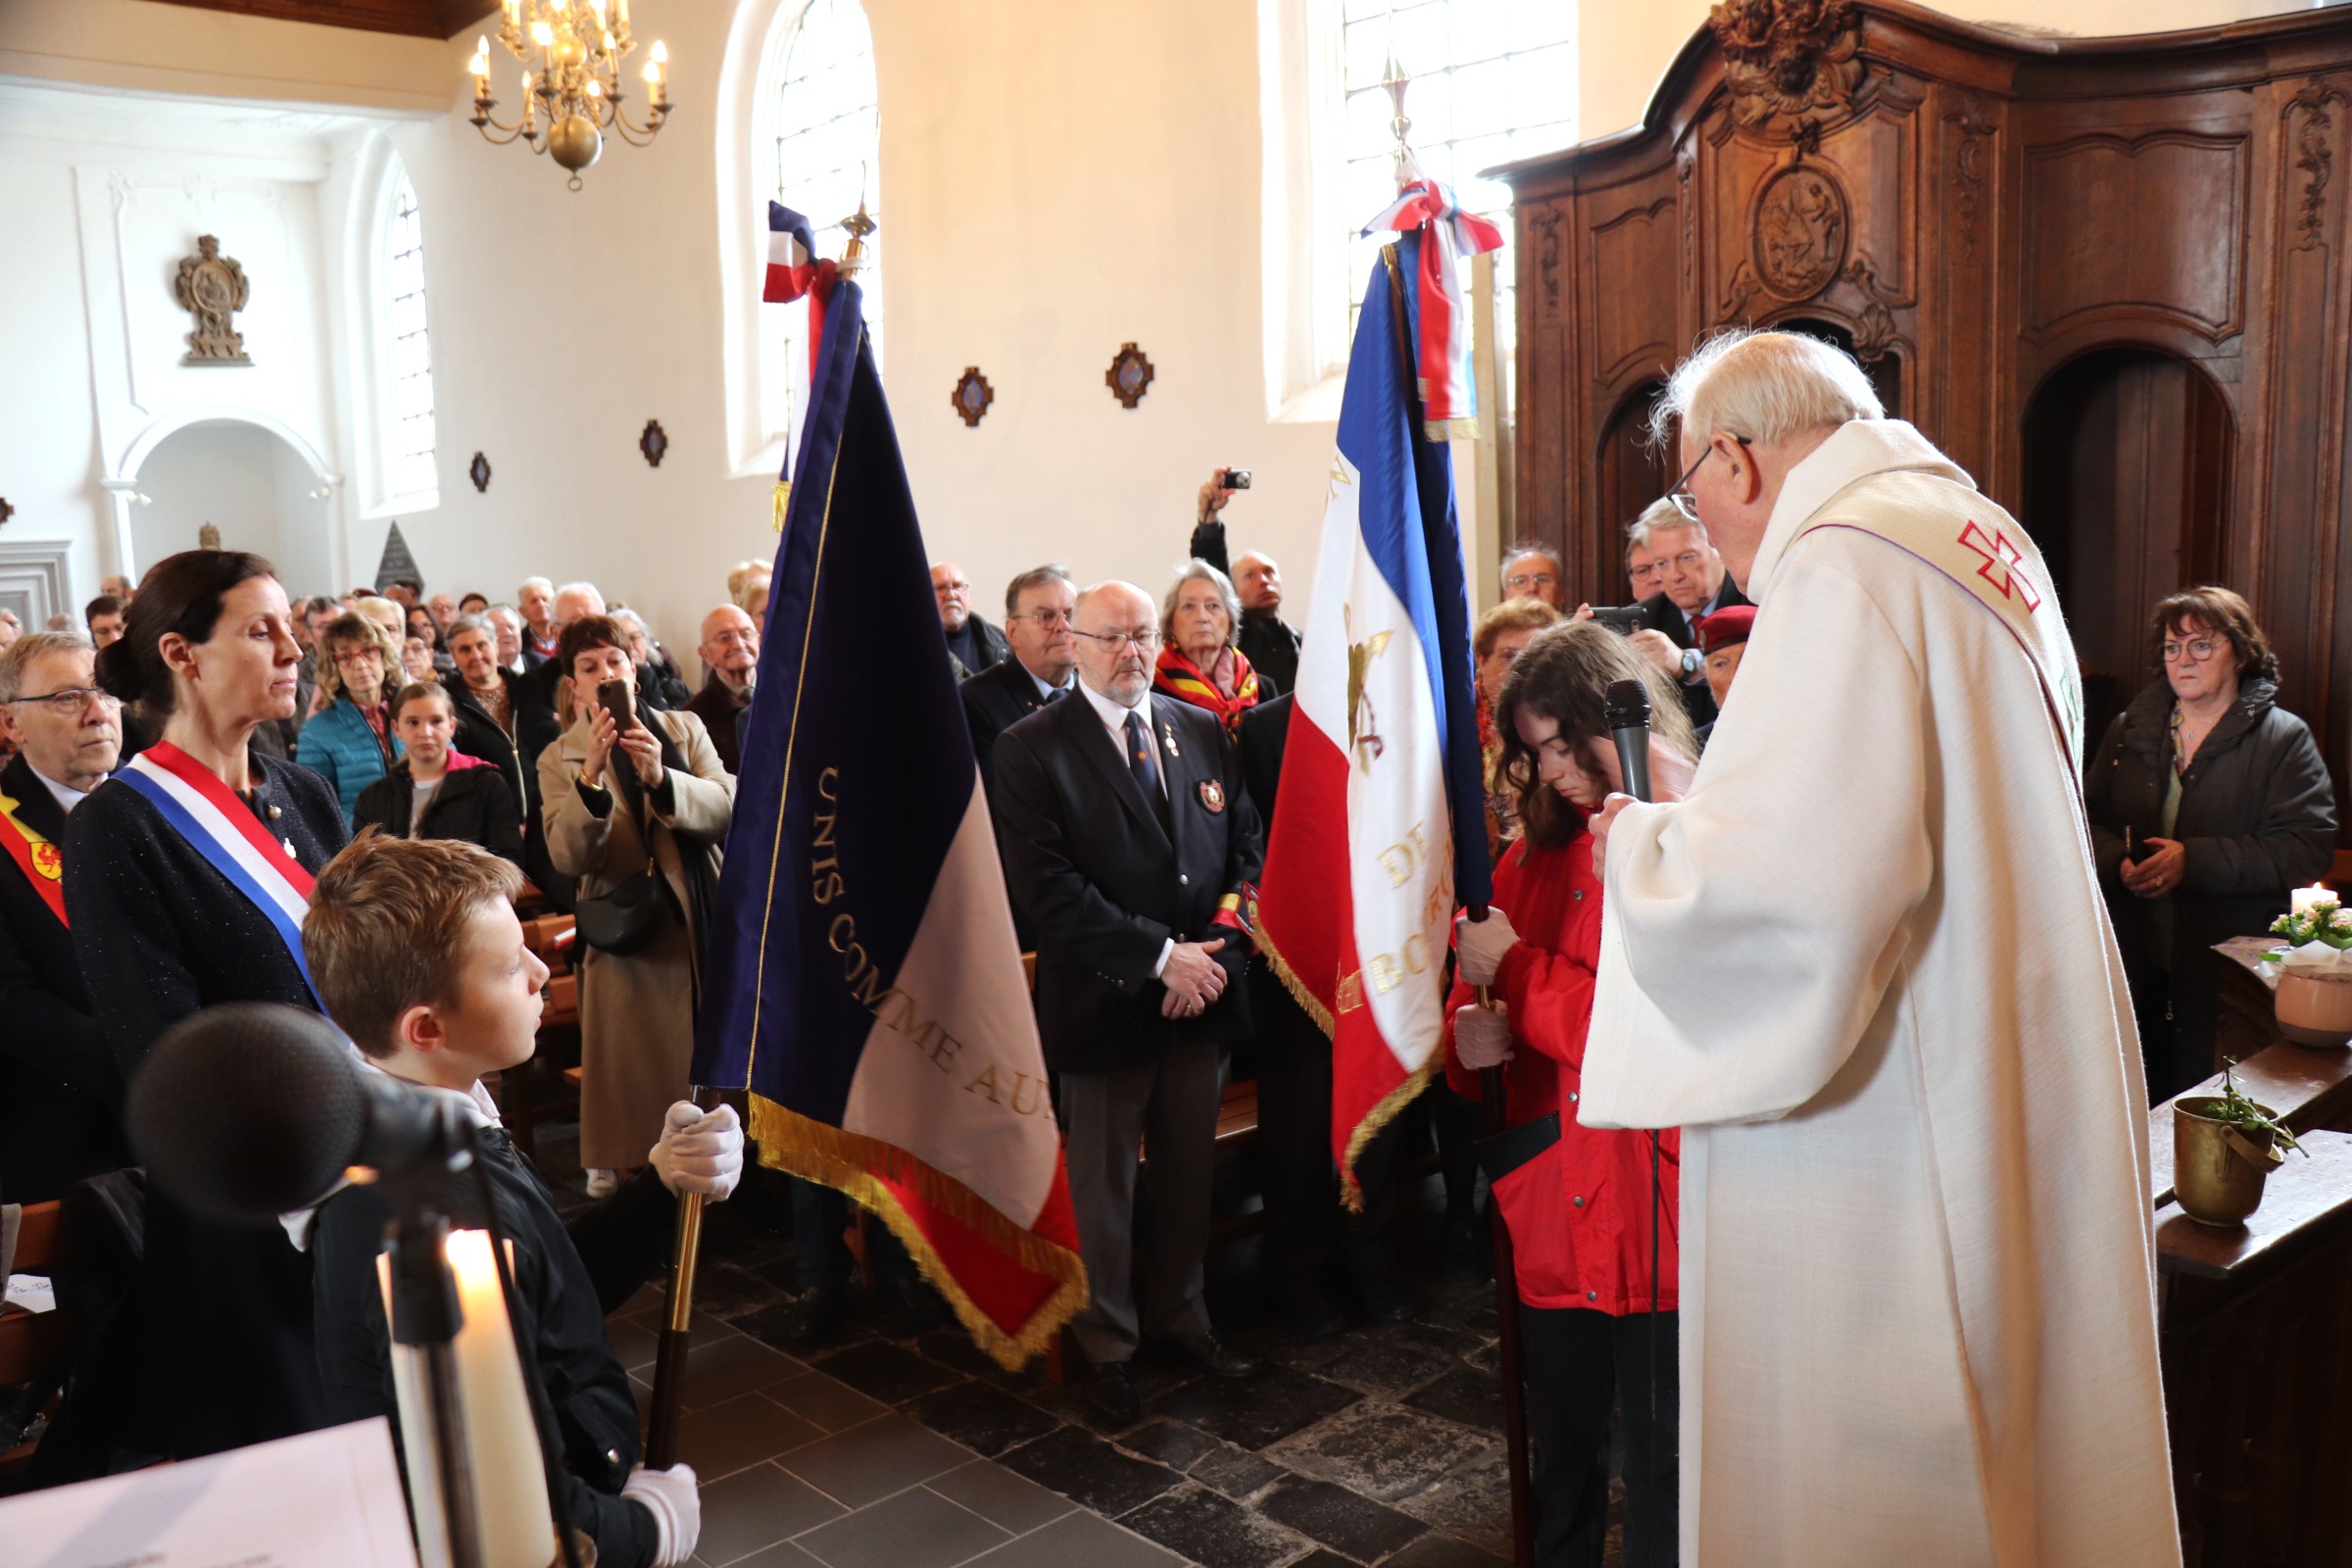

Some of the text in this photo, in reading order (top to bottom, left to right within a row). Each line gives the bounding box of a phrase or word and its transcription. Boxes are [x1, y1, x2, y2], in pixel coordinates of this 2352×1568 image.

[812, 766, 1057, 1120] UNIS COMME AU
